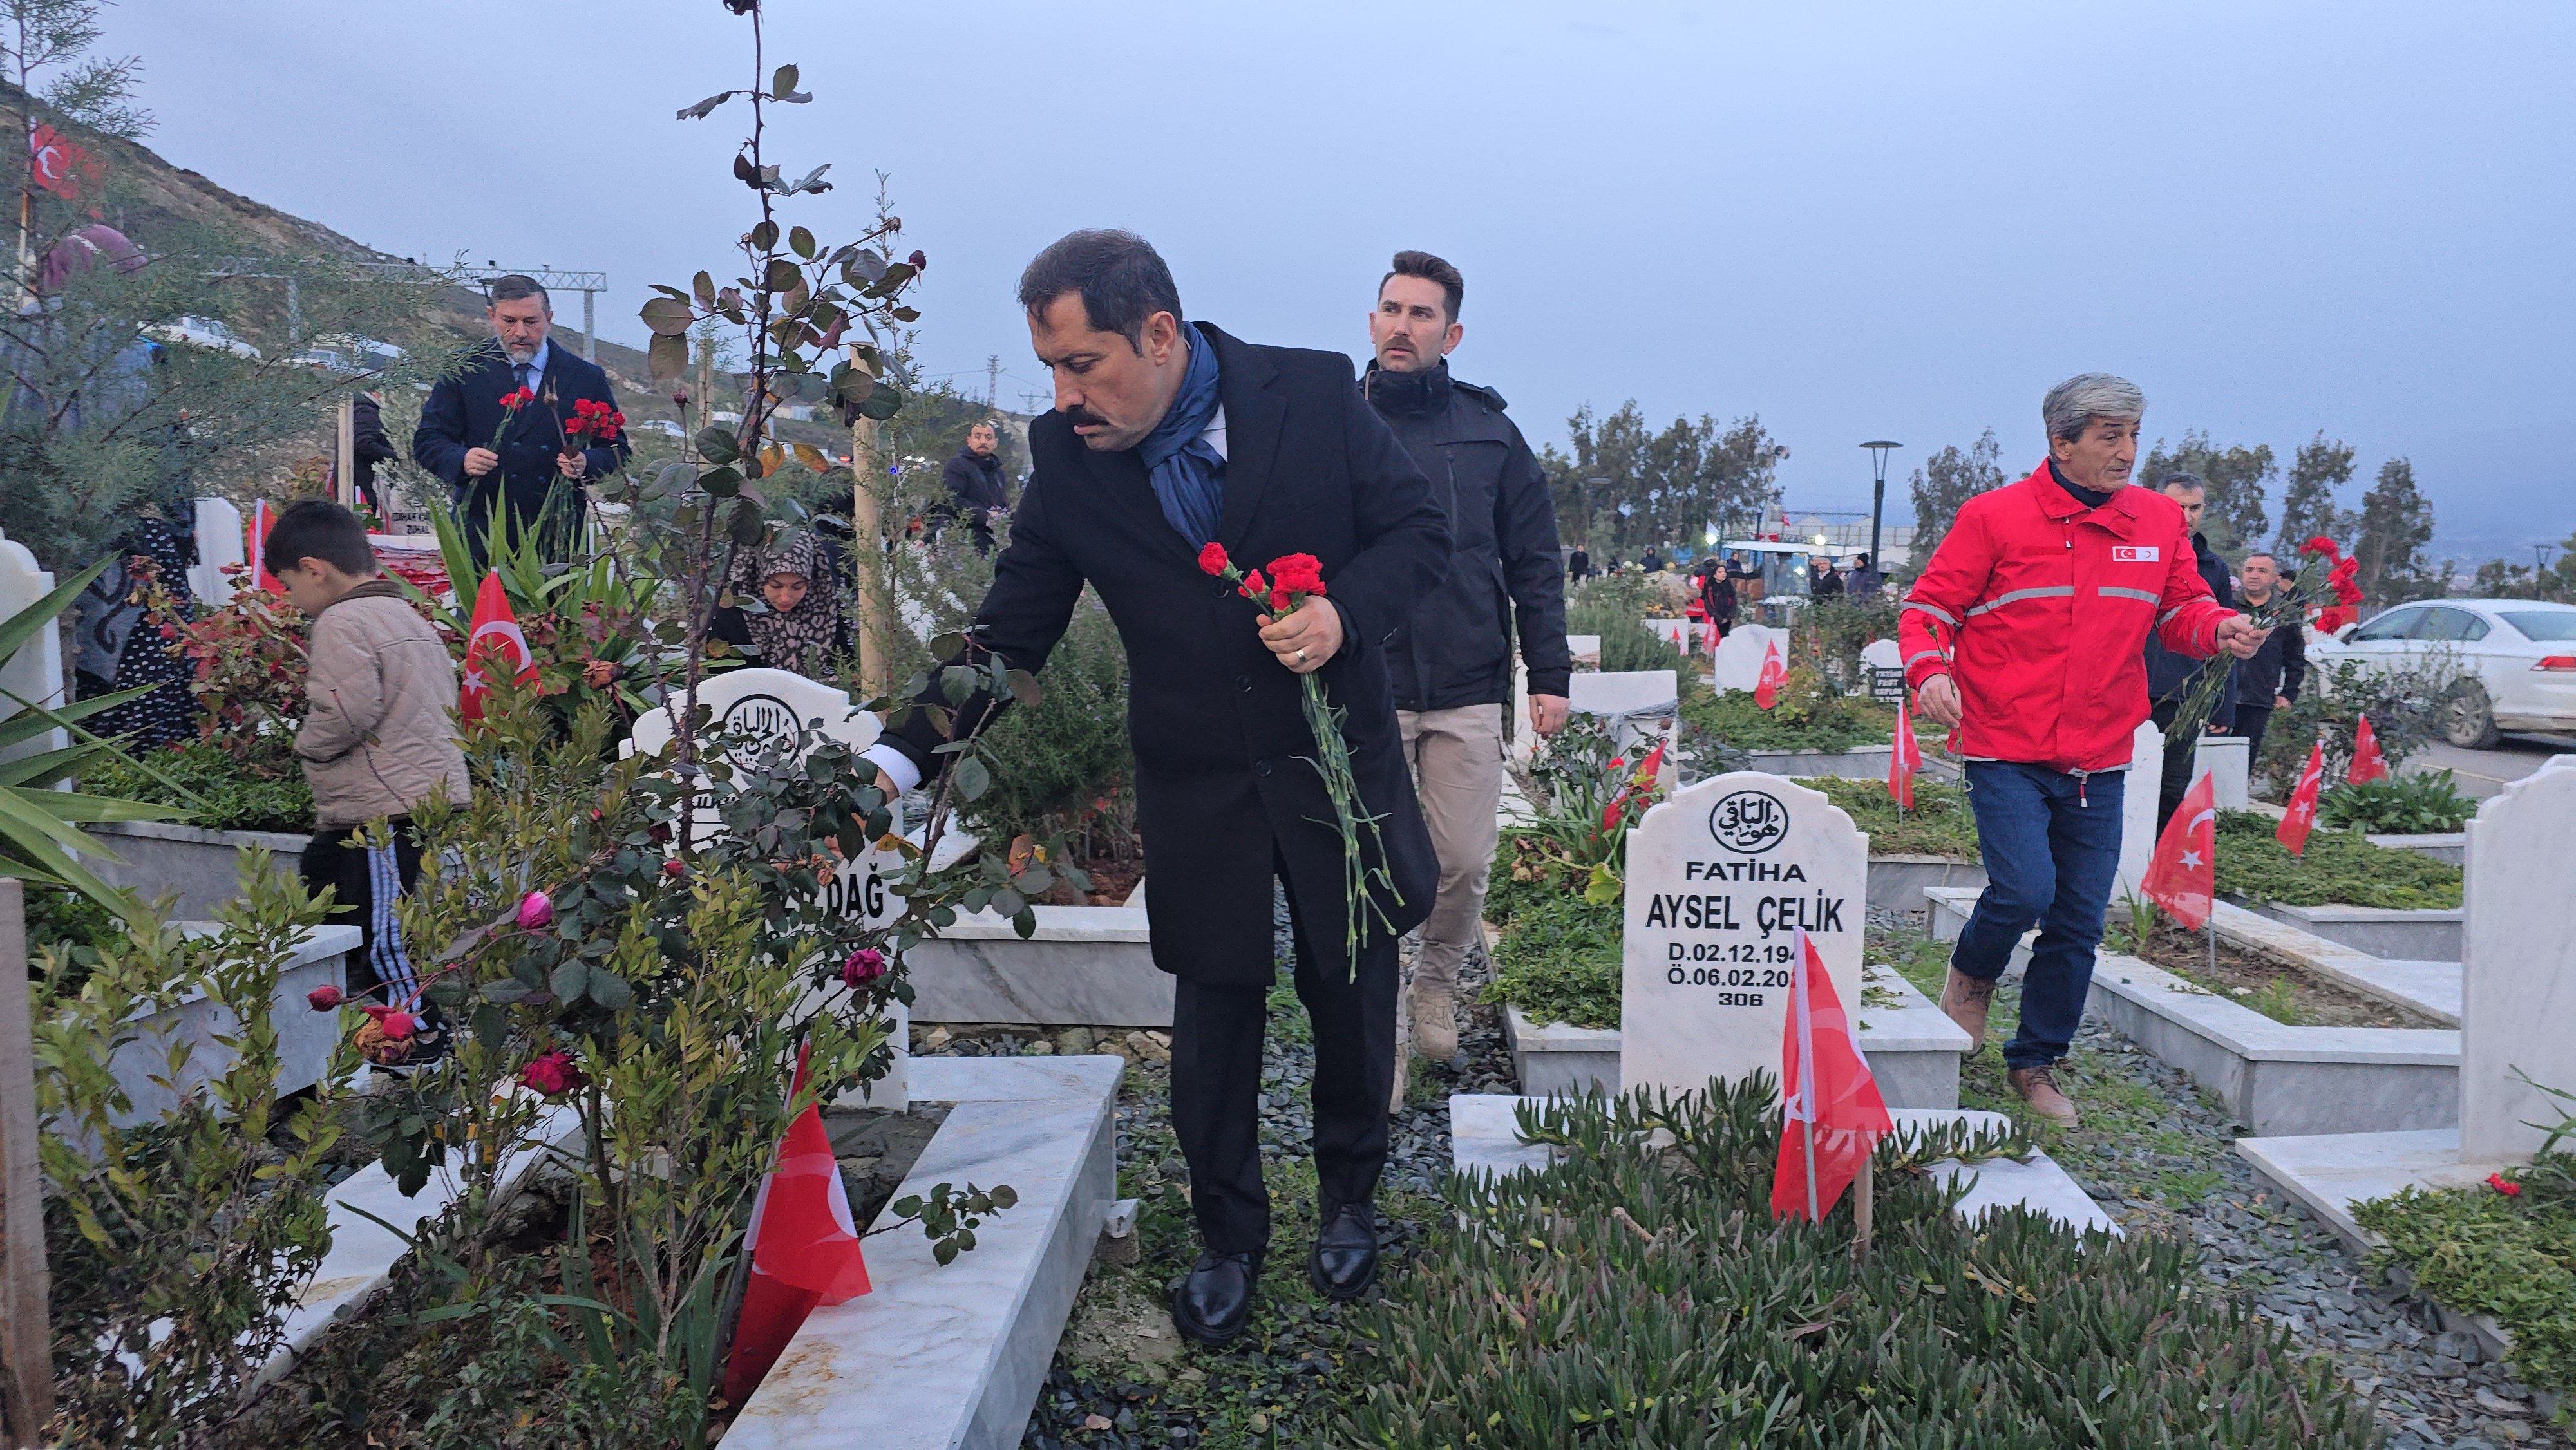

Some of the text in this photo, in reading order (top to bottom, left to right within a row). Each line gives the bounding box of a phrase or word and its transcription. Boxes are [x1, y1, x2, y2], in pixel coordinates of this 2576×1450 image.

[1685, 858, 1807, 883] FATİHA
[815, 862, 884, 919] DAĞ
[1645, 889, 1845, 940] AYSEL ÇELİK
[1669, 943, 1795, 964] D.02.12.19
[1667, 963, 1790, 988] Ö.06.02.20
[1718, 993, 1764, 1006] 306
